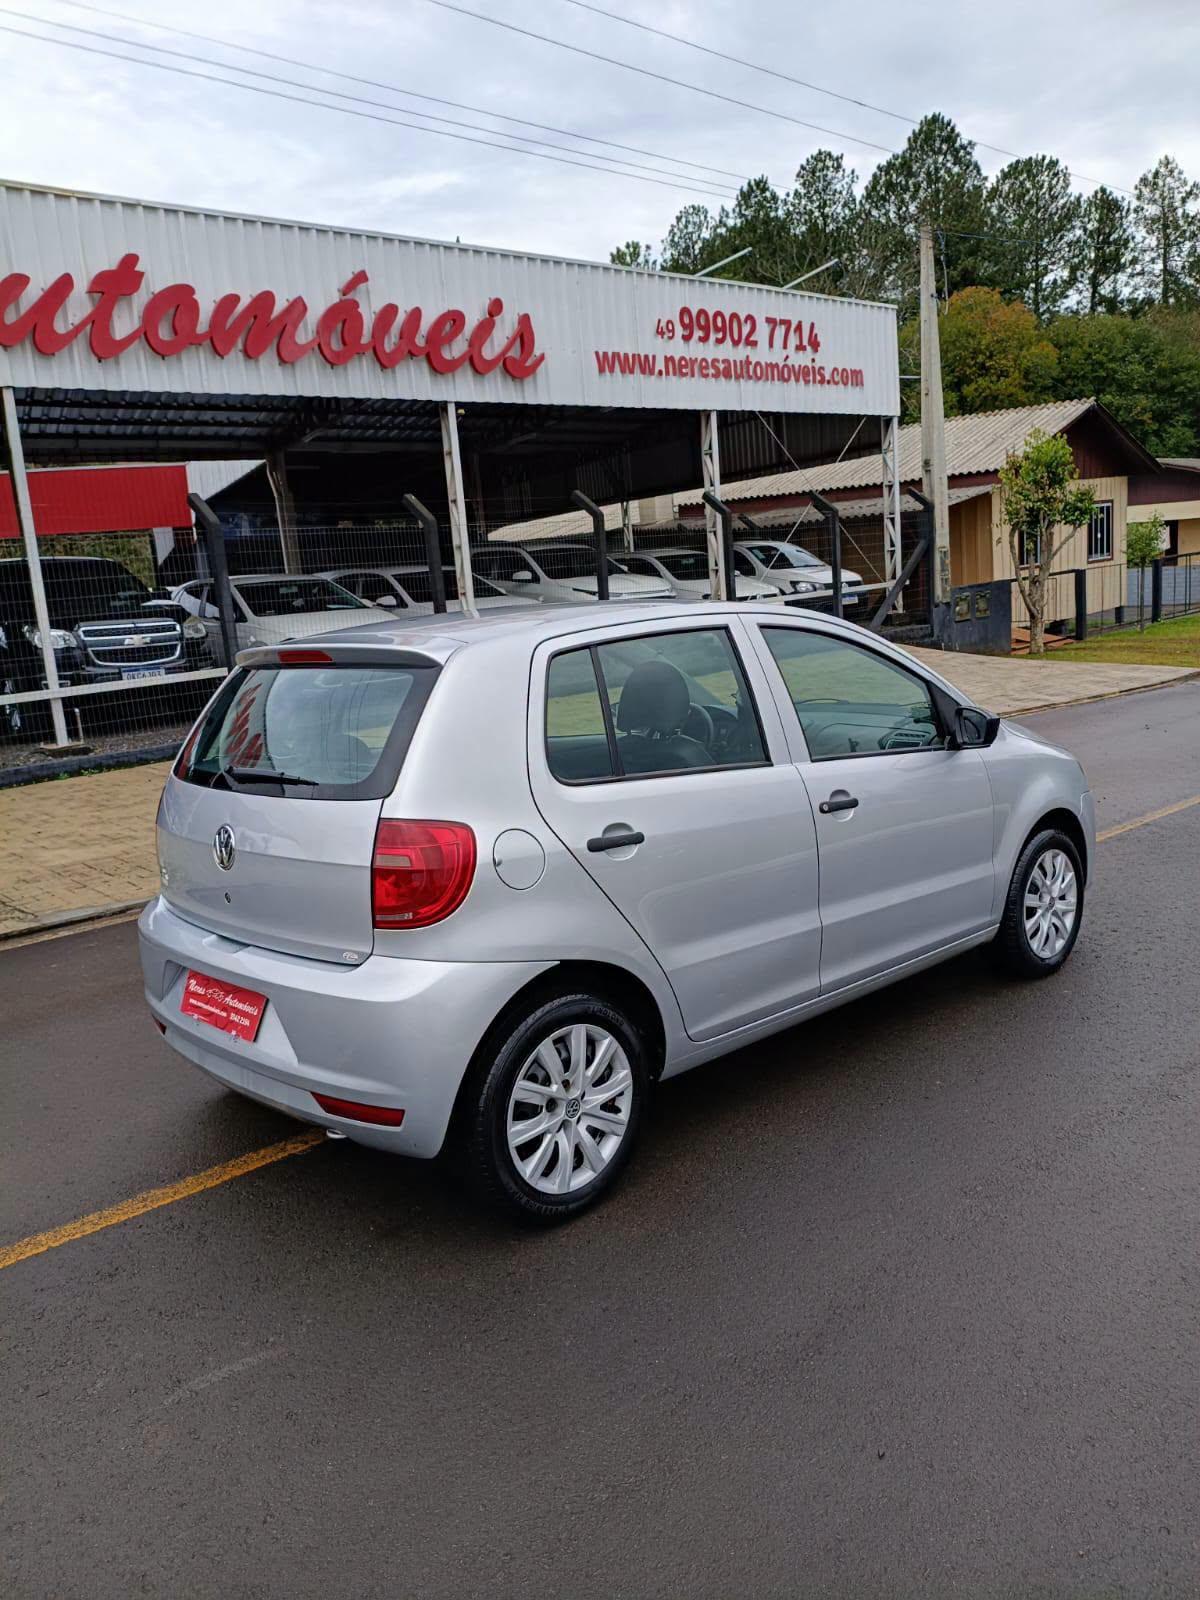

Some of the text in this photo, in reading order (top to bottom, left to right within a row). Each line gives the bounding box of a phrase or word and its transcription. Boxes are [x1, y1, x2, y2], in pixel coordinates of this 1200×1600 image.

[0, 253, 544, 379] utomóveis
[656, 306, 821, 353] 49 99902 7714
[595, 350, 865, 387] www.neresautomóveis.com
